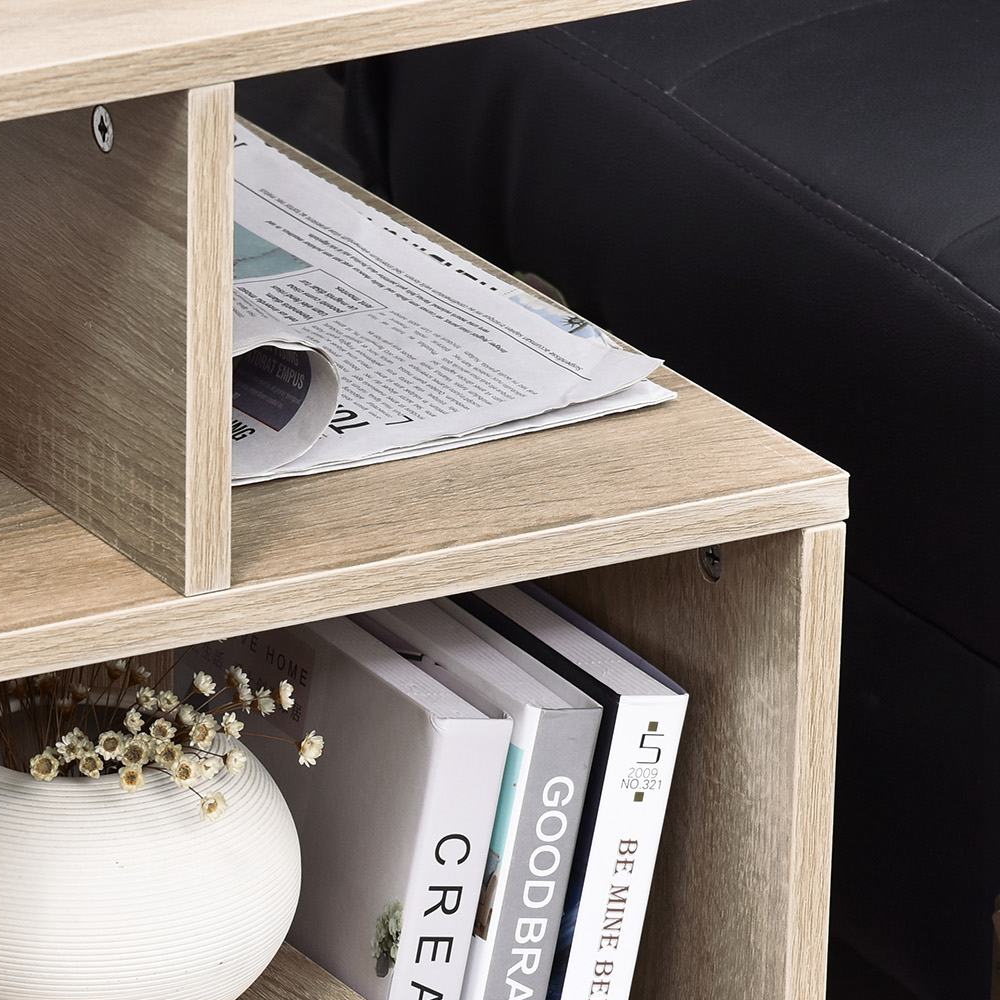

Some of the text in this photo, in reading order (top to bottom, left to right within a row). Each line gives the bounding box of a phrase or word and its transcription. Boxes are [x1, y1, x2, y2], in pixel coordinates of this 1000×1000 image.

[265, 645, 308, 687] HOME
[627, 767, 659, 779] 2009
[611, 838, 639, 876] BE
[600, 883, 627, 951] MINE
